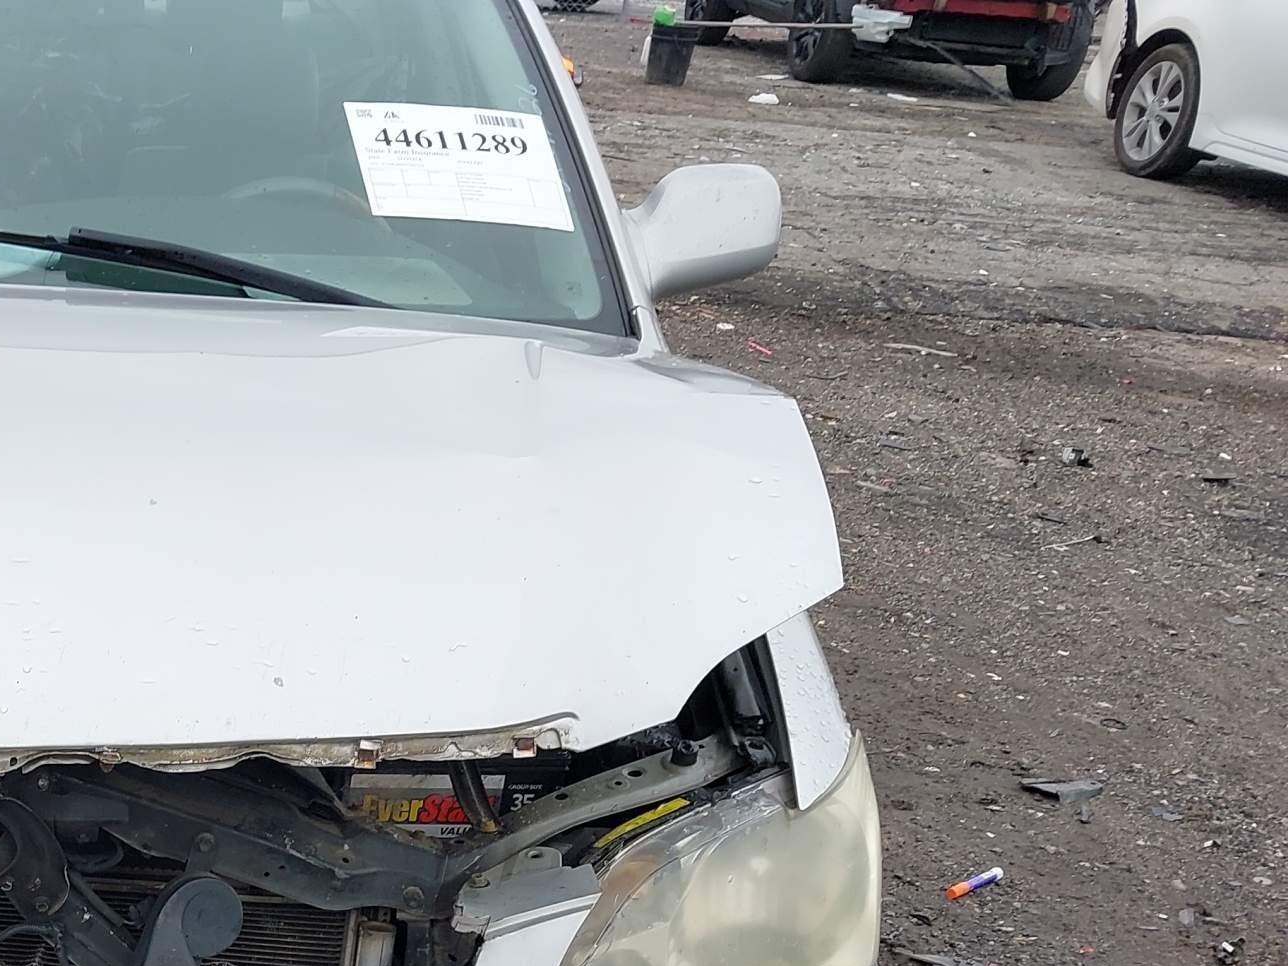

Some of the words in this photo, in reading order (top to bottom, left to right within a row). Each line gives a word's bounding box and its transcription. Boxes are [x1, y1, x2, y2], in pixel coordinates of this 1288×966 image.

[374, 127, 528, 156] 44611289
[362, 793, 499, 824] EverSta
[510, 793, 536, 812] 35
